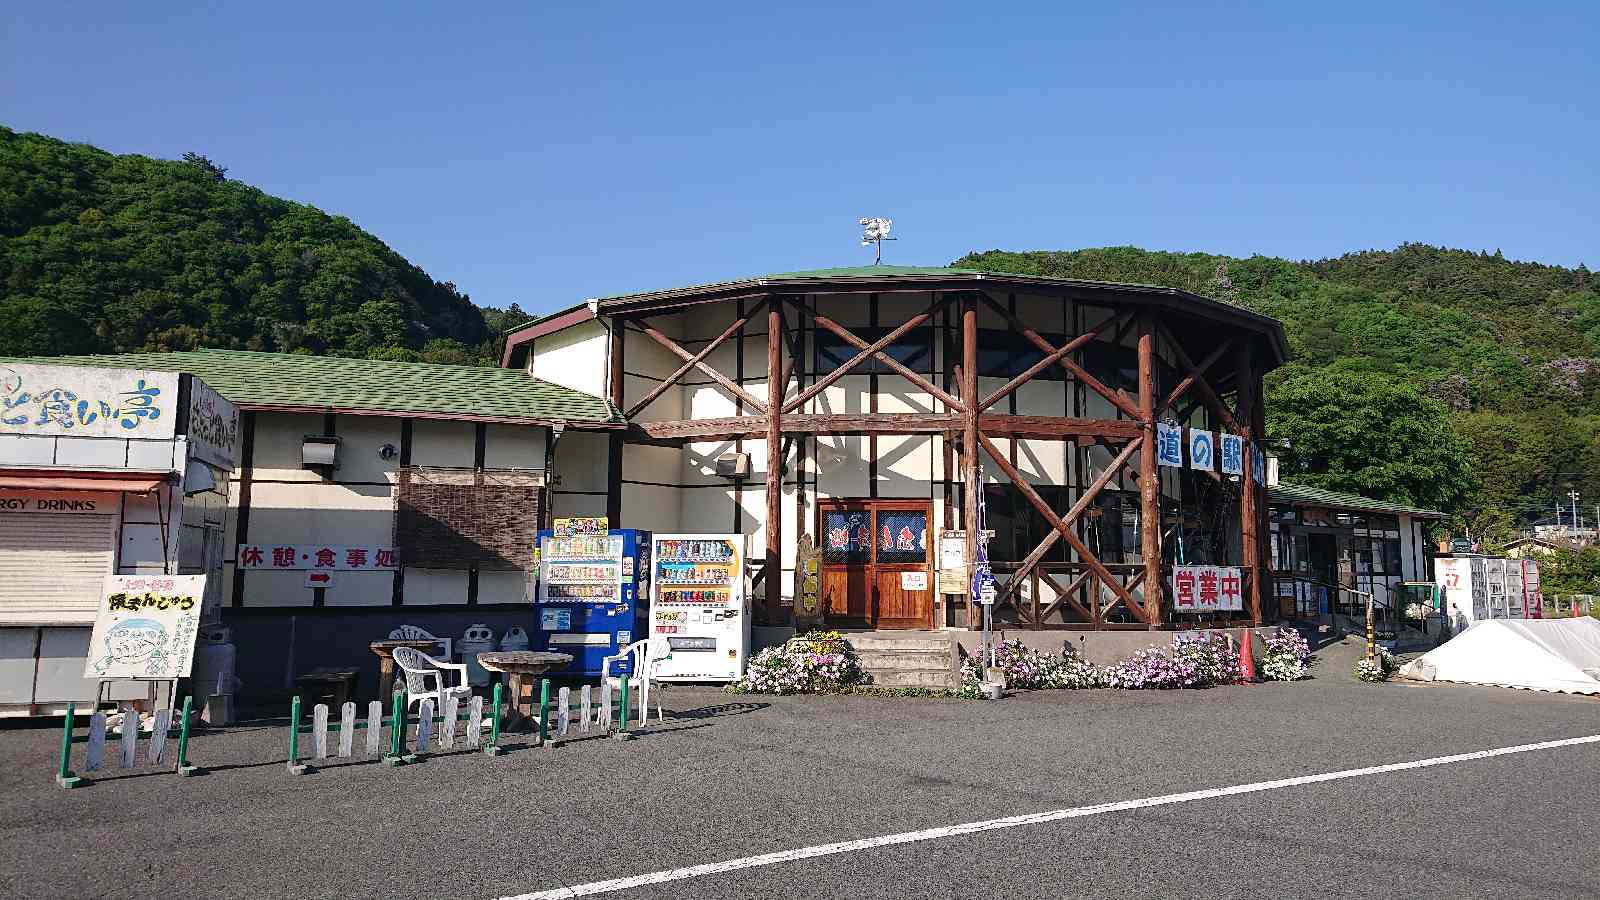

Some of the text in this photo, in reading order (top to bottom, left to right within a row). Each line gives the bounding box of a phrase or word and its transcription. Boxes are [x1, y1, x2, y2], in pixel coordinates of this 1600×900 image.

[1159, 430, 1242, 471] 道の駅
[37, 500, 96, 511] DRINKS
[1175, 569, 1240, 607] 営業中
